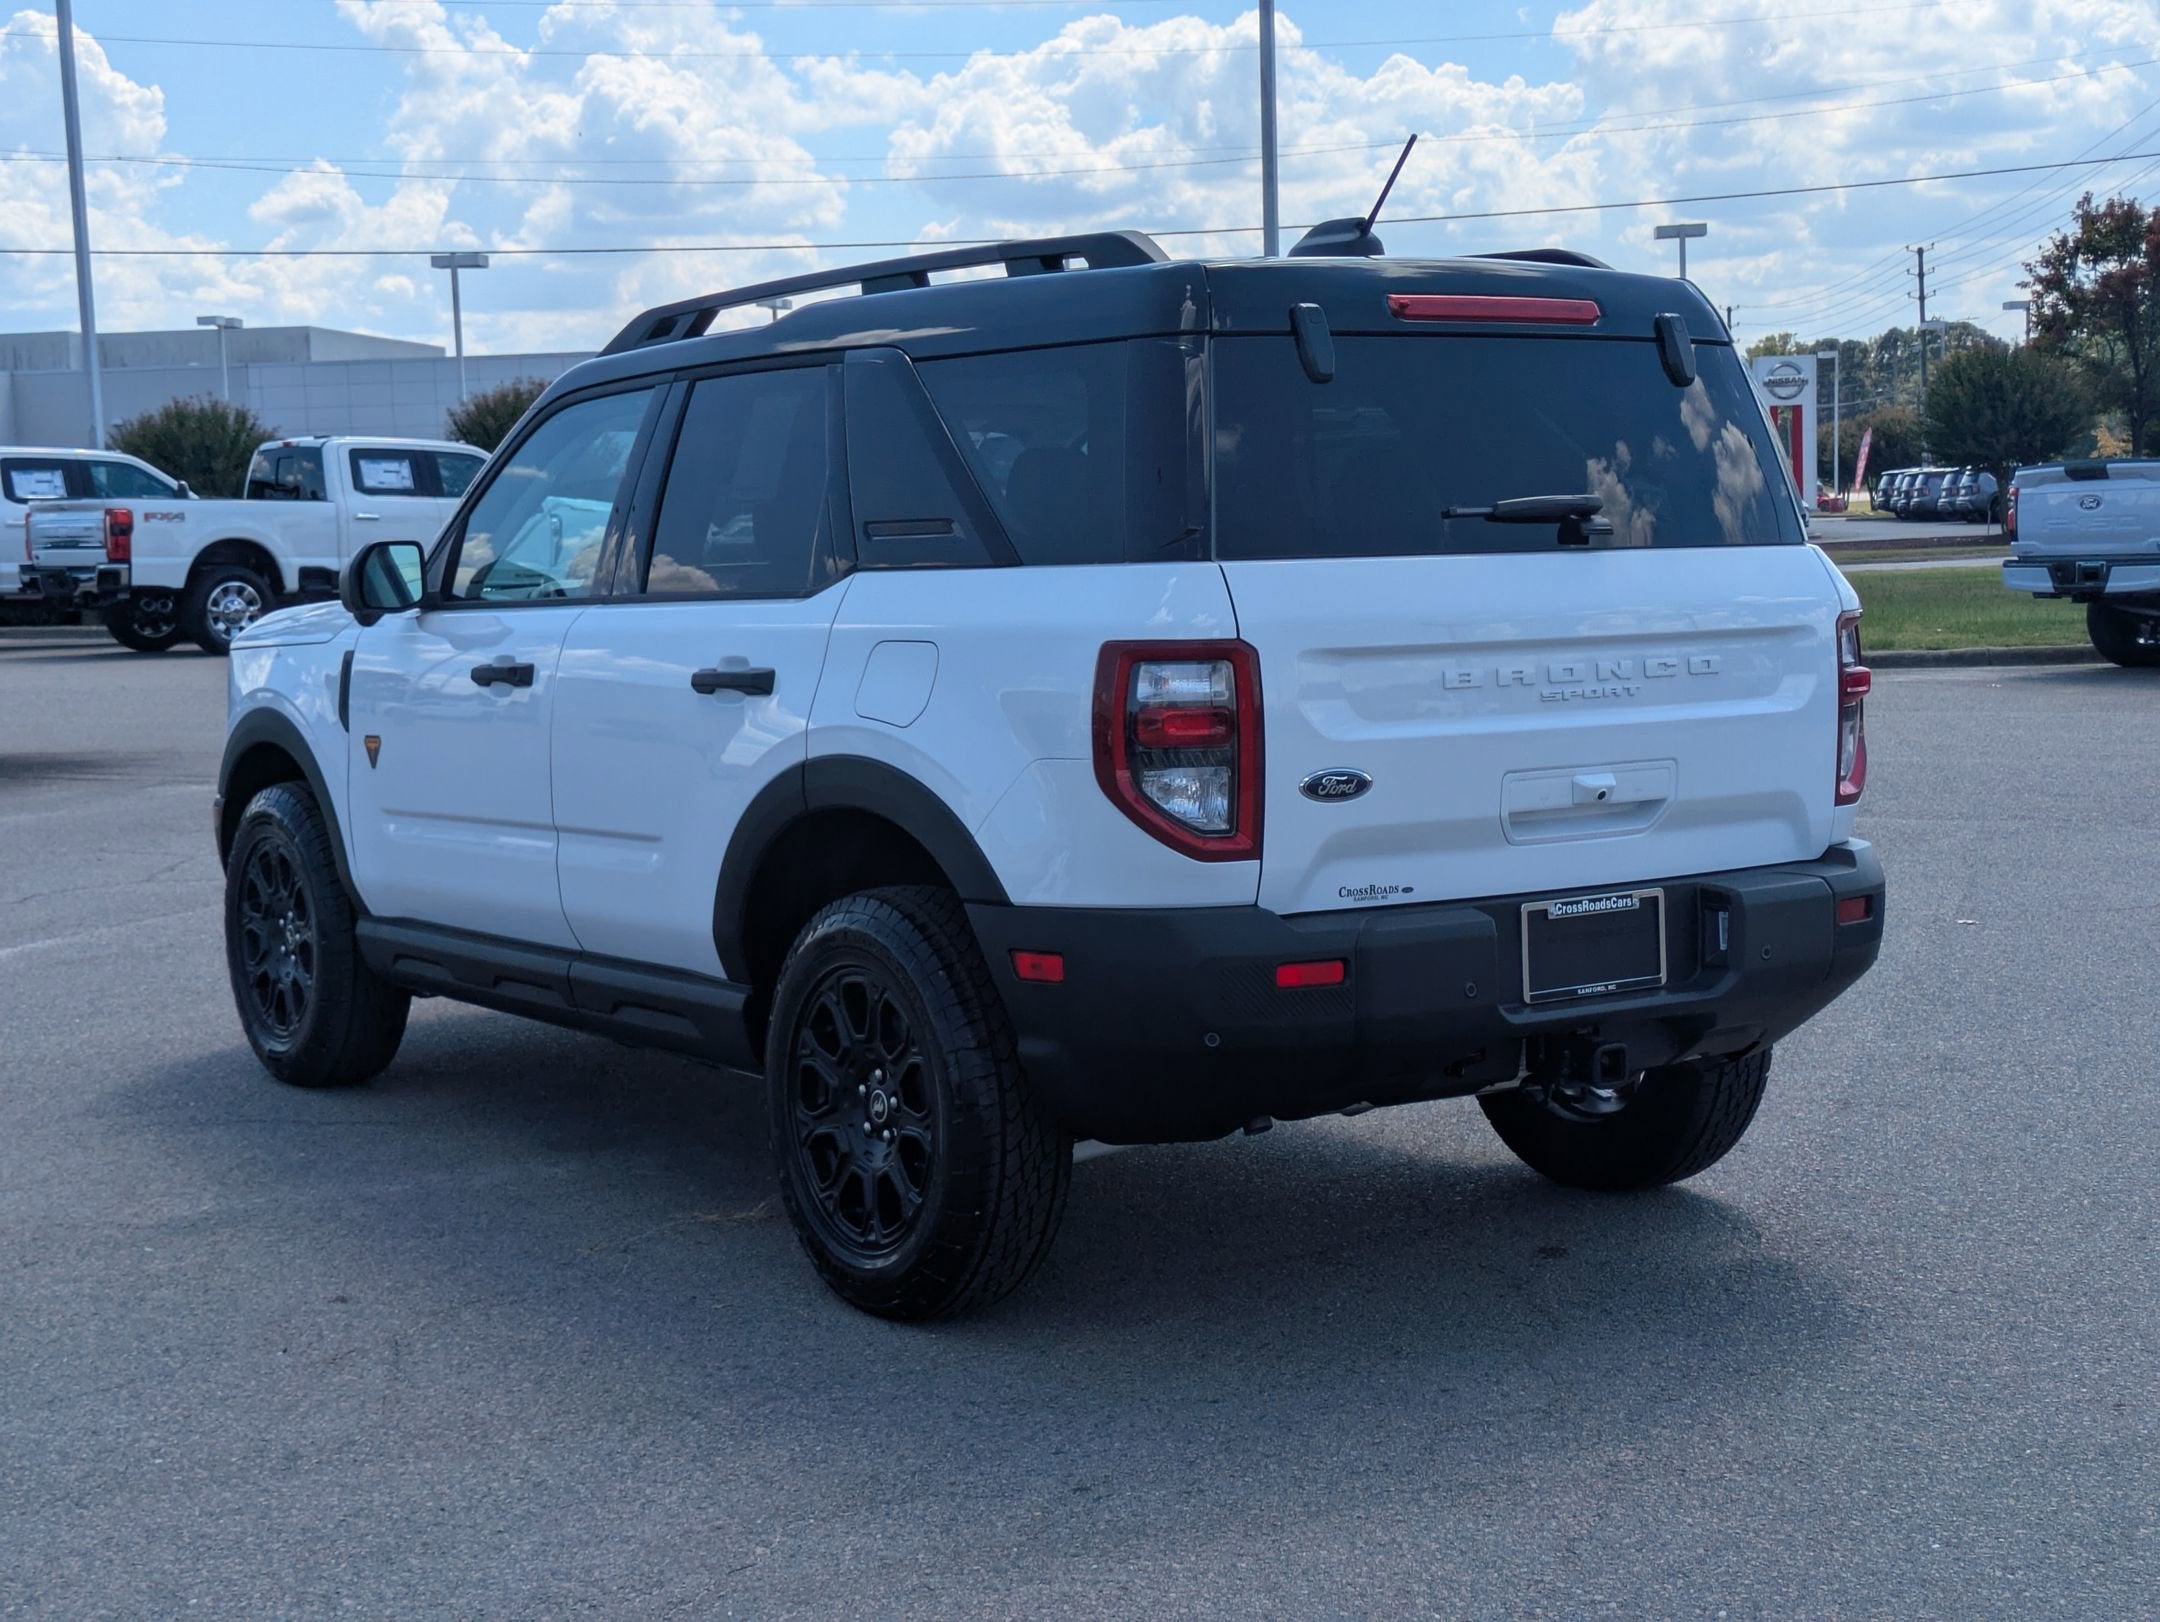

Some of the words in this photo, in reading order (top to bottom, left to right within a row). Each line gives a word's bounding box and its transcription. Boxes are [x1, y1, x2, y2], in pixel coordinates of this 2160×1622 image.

[1767, 376, 1806, 385] NISSAN
[144, 512, 185, 522] FX4
[1442, 655, 1721, 690] BRONCO
[1540, 686, 1643, 702] SPORT
[1318, 776, 1358, 796] Ford
[1555, 897, 1632, 915] CrossRoadsCars
